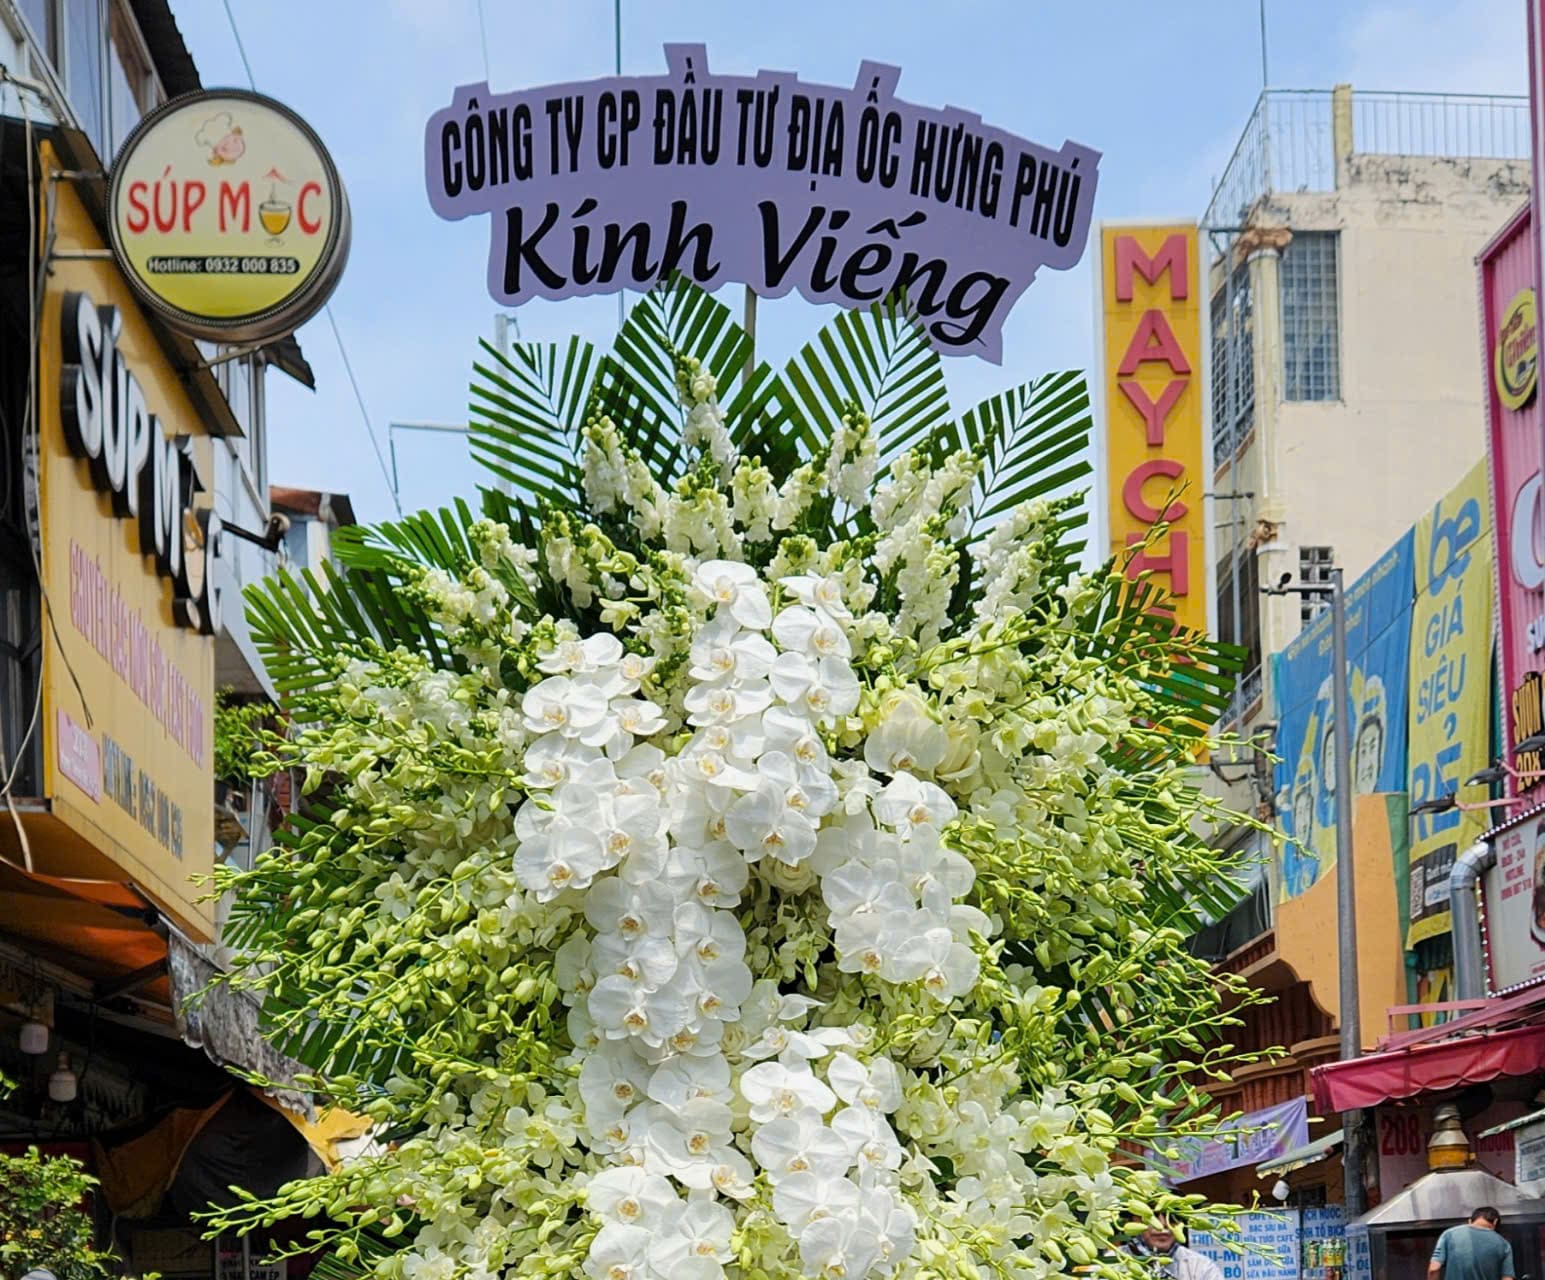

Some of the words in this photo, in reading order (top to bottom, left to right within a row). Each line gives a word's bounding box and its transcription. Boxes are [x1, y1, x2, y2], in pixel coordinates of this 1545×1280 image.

[441, 97, 533, 198] CÔNG
[546, 95, 586, 176] TY
[598, 88, 640, 170] CP
[652, 57, 723, 167] ĐẦU
[736, 84, 780, 169] TƯ
[787, 93, 845, 192] ĐỊA
[857, 77, 903, 189] ỐC
[909, 118, 1003, 221] HƯNG
[1010, 156, 1082, 249] PHÚ
[126, 165, 207, 234] SÚP
[149, 257, 201, 273] Hotline:
[205, 258, 238, 272] 0932
[242, 258, 268, 272] 000
[270, 258, 296, 272] 835
[503, 198, 720, 296] Kính
[757, 199, 1011, 348] Viếng
[73, 292, 150, 518] SÚP
[1428, 497, 1481, 597] be
[1425, 578, 1464, 658] GIÁ
[1417, 653, 1466, 725] SIÊU
[1408, 712, 1463, 847] RẺ
[1381, 1113, 1420, 1155] 208
